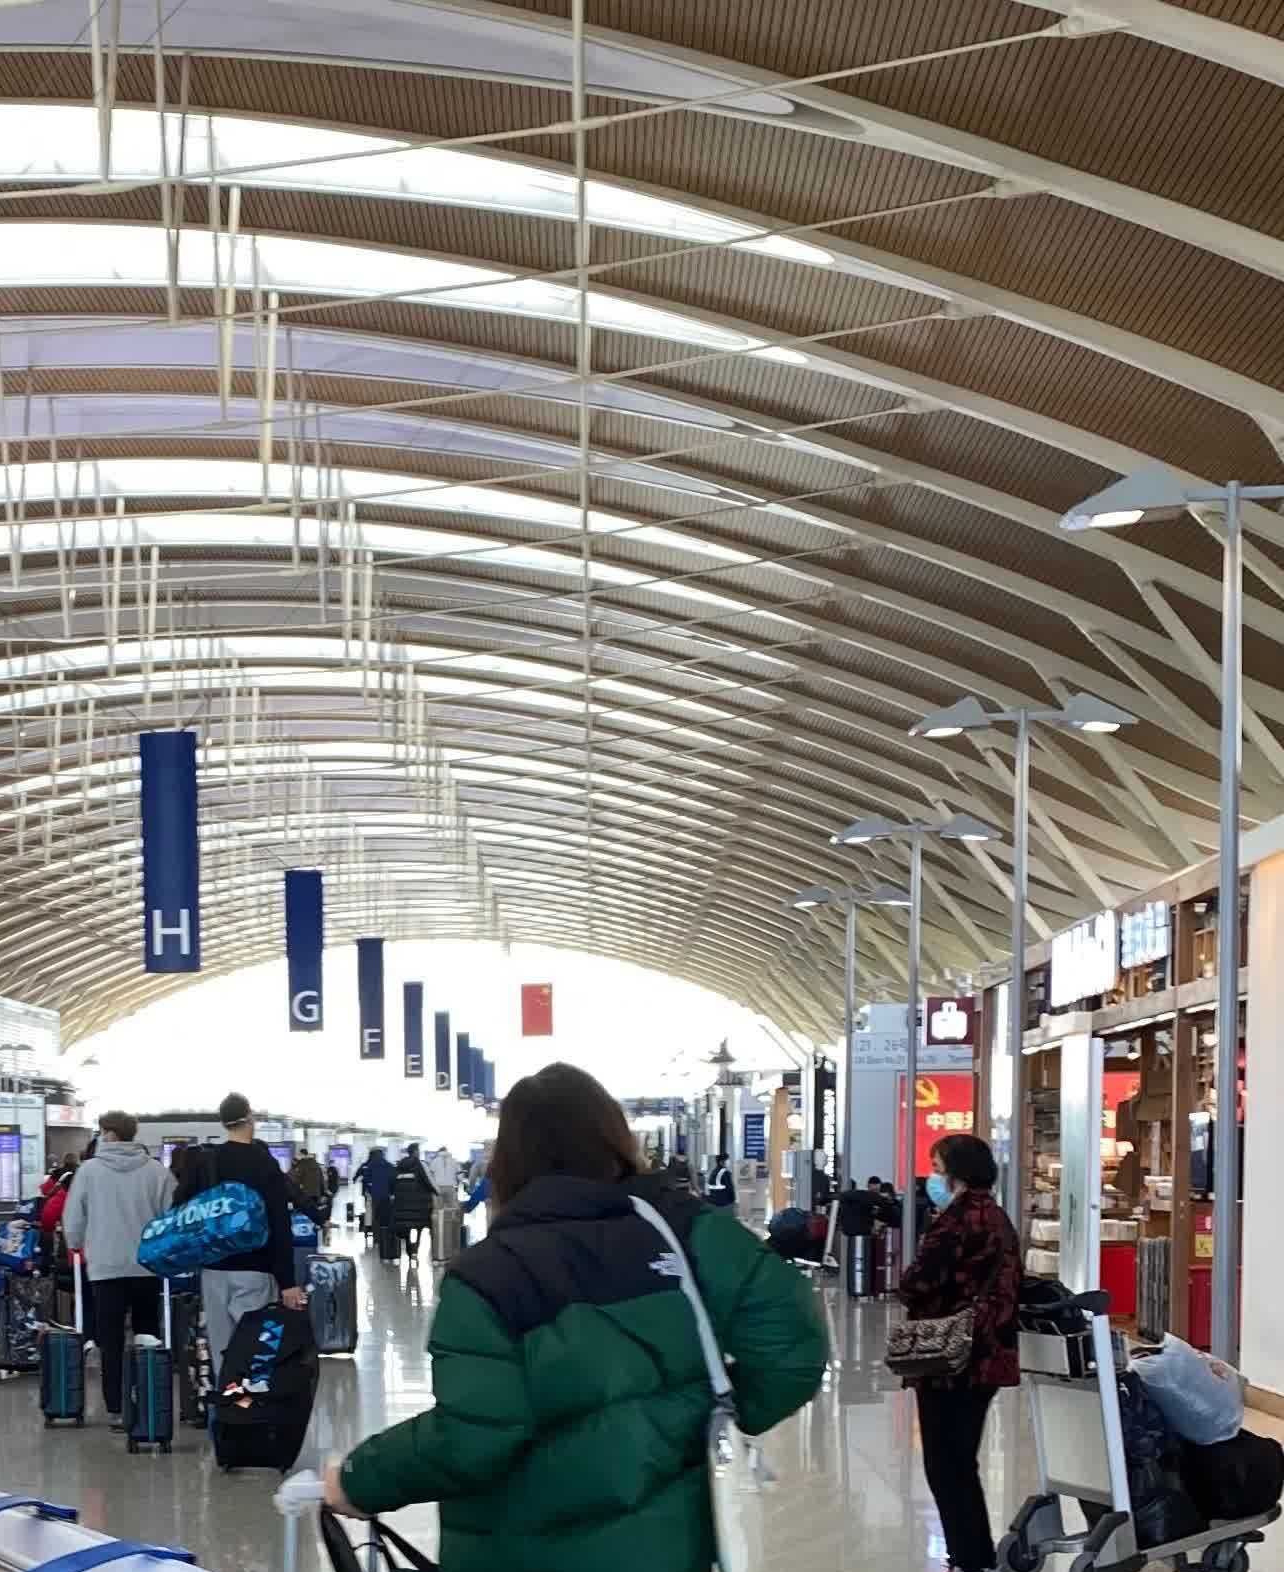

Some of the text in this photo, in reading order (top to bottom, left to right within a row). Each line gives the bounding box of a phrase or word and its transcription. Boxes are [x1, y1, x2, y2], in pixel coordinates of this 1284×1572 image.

[152, 909, 192, 956] H
[292, 990, 320, 1023] G
[363, 1028, 381, 1054] F
[406, 1054, 421, 1074] E
[436, 1072, 449, 1088] D
[176, 1197, 236, 1227] YONEX
